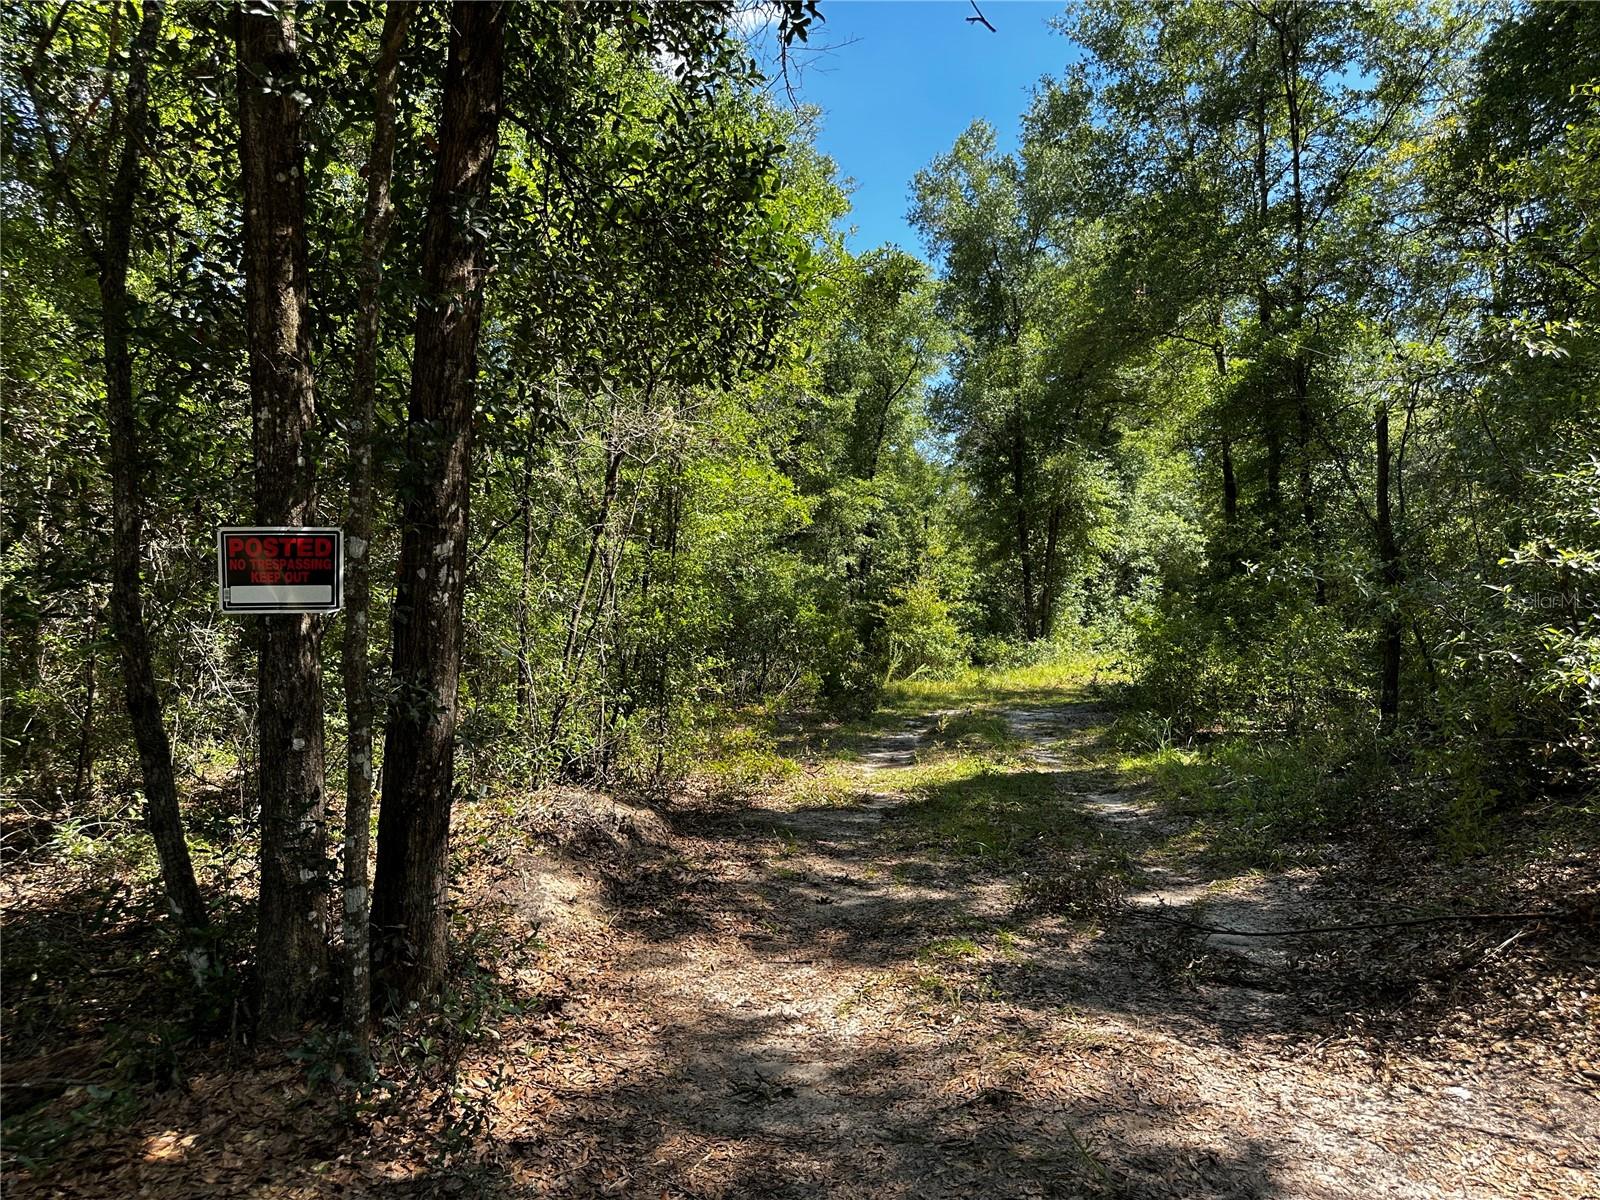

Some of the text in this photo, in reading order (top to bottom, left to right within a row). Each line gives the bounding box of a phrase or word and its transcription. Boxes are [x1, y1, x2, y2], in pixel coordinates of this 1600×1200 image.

[228, 537, 332, 557] POSTED
[229, 559, 332, 570] NO TRESPASSING
[250, 571, 310, 584] KEEP OUT
